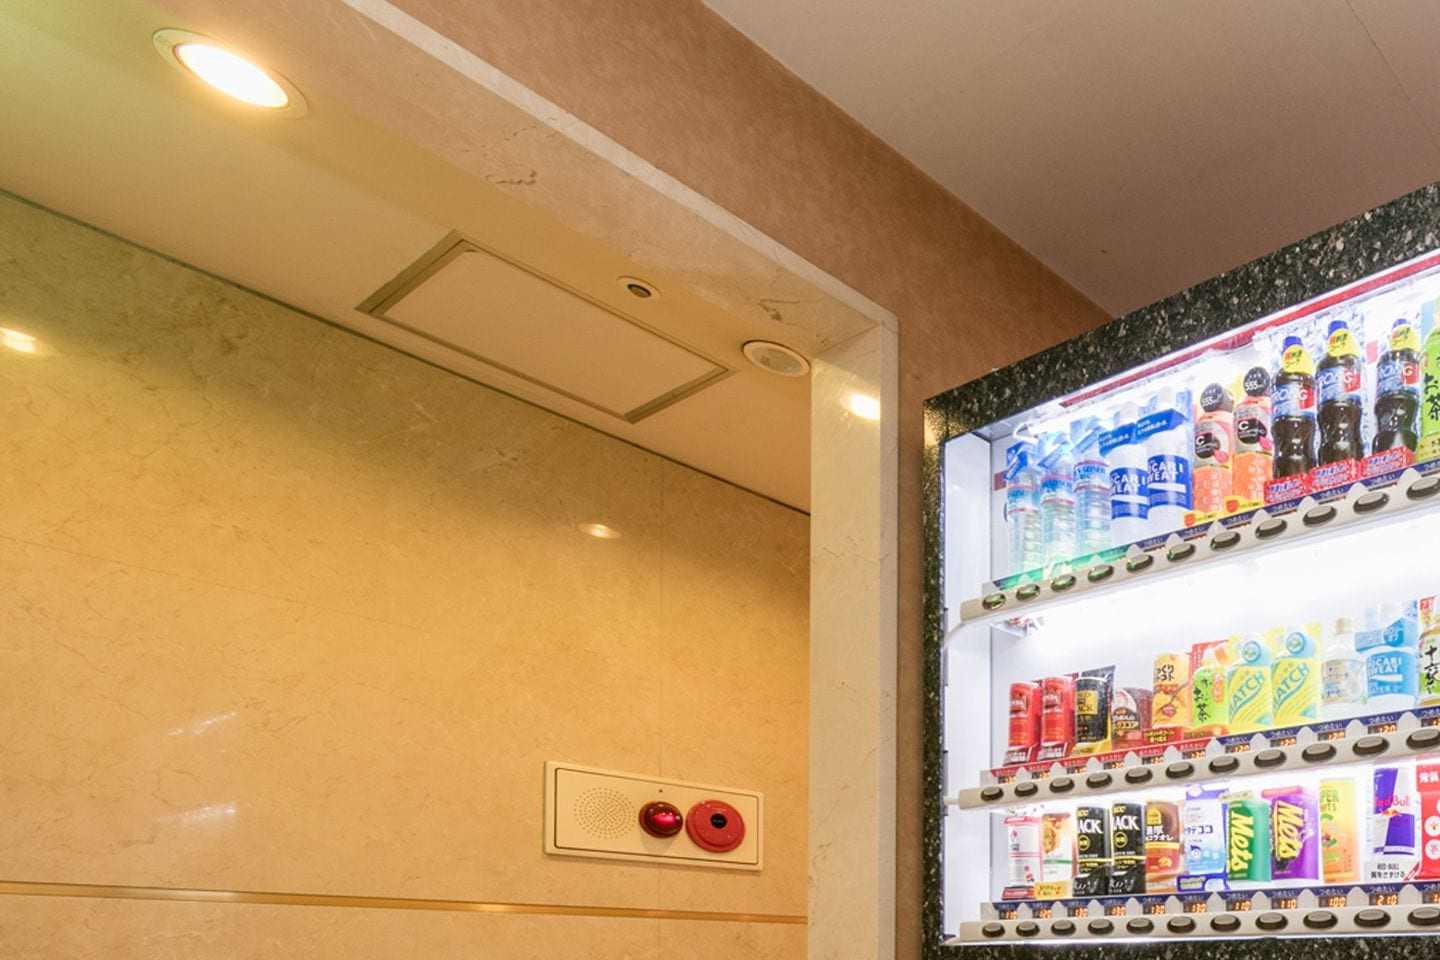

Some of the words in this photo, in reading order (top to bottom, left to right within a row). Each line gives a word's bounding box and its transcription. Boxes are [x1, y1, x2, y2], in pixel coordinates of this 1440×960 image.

[1078, 819, 1103, 834] ACK
[1113, 815, 1139, 831] ACK
[1277, 800, 1305, 858] Mets
[1231, 811, 1254, 871] Mets
[1377, 895, 1398, 905] 210
